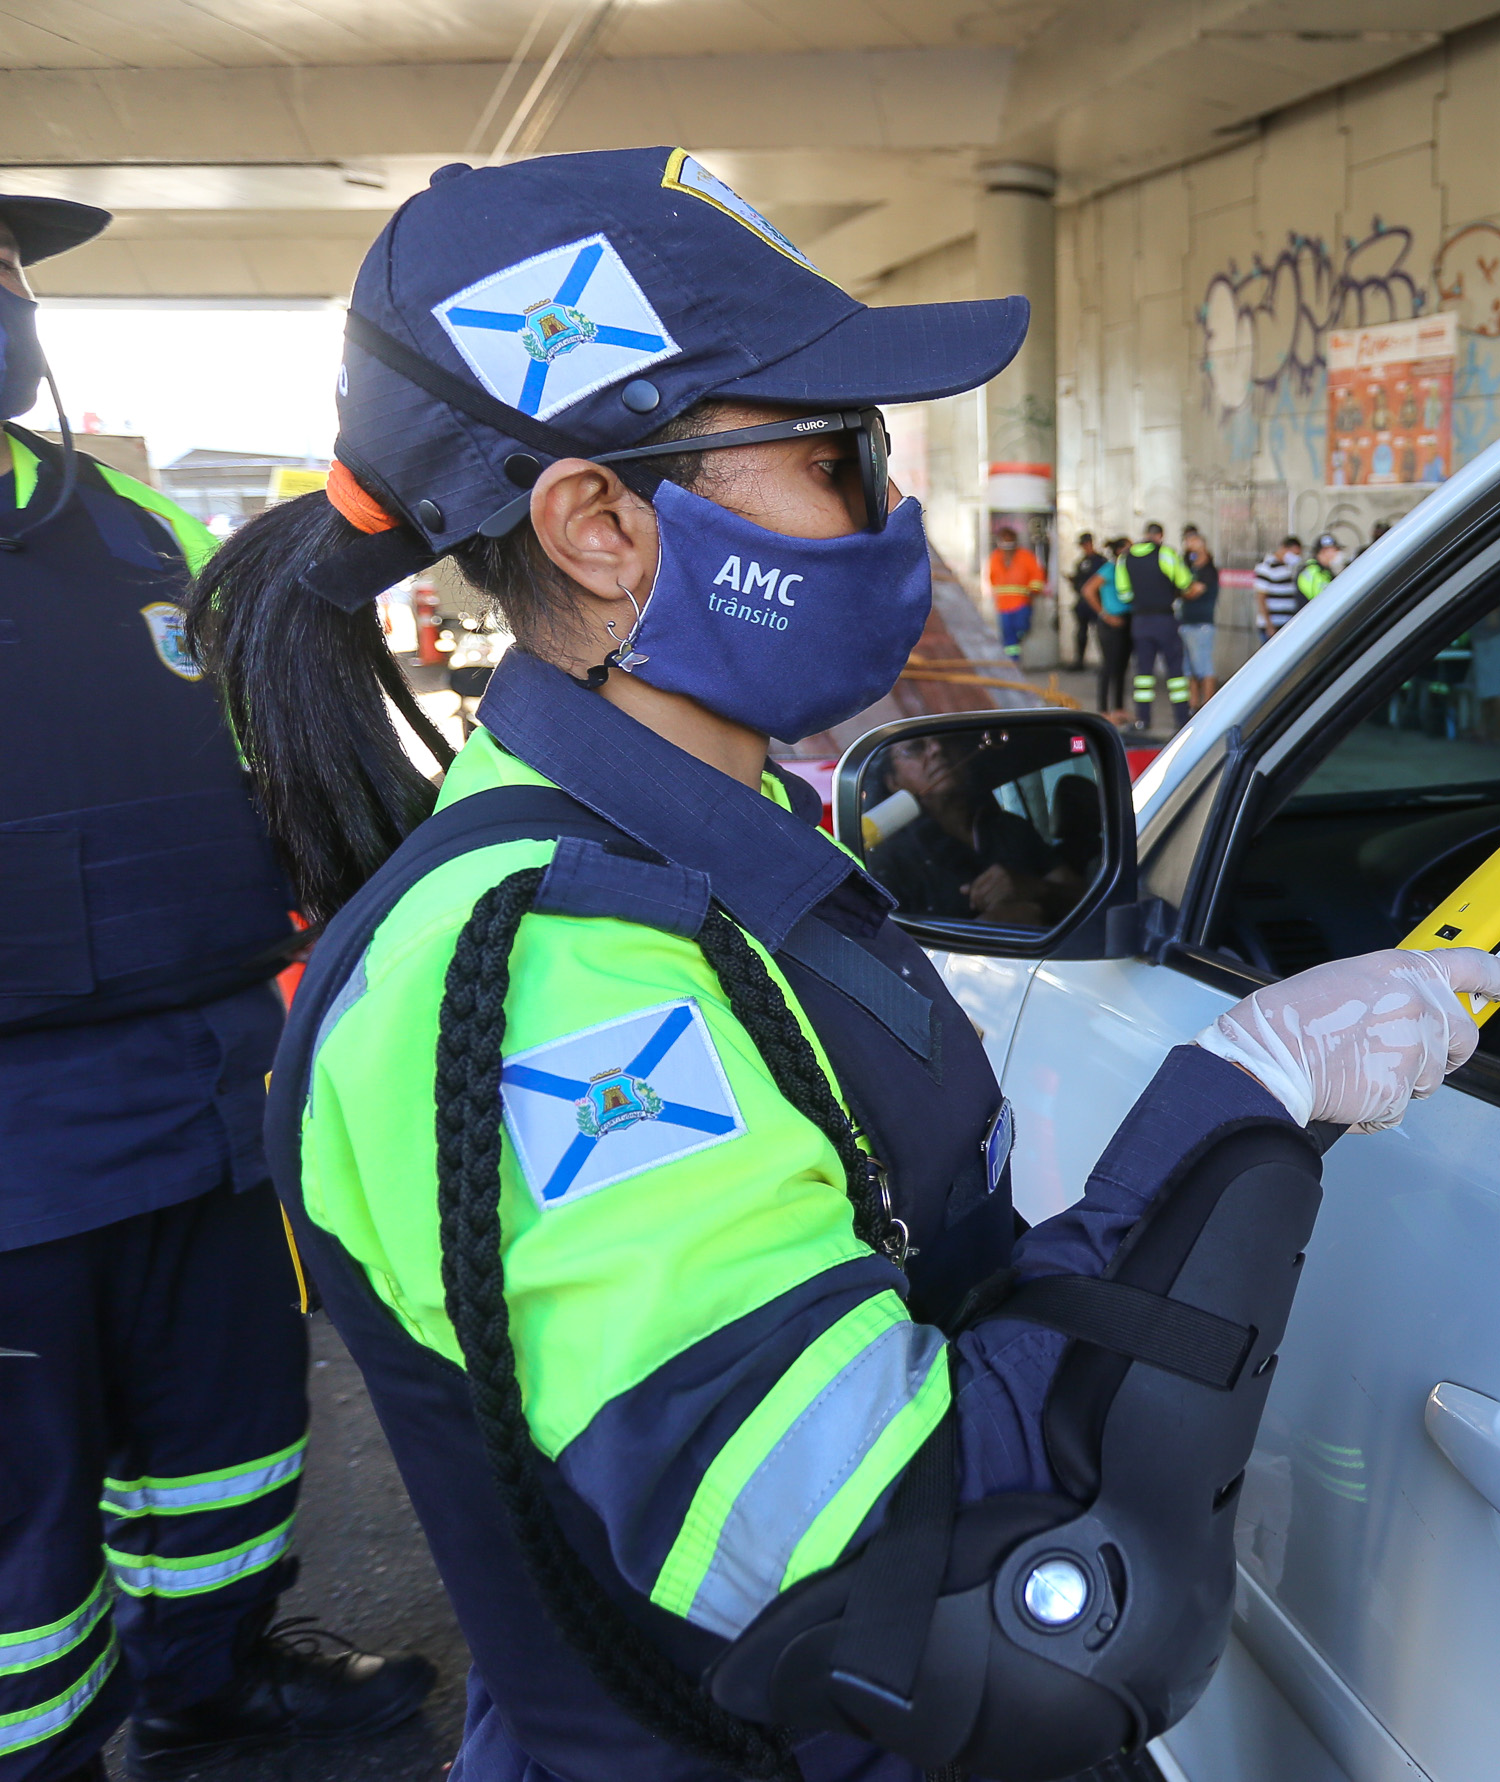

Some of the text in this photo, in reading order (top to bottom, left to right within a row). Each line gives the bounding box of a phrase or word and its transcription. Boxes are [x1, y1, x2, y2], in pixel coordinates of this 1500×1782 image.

[795, 419, 826, 431] EURO
[712, 554, 804, 607] AMC
[708, 592, 789, 631] trânsito
